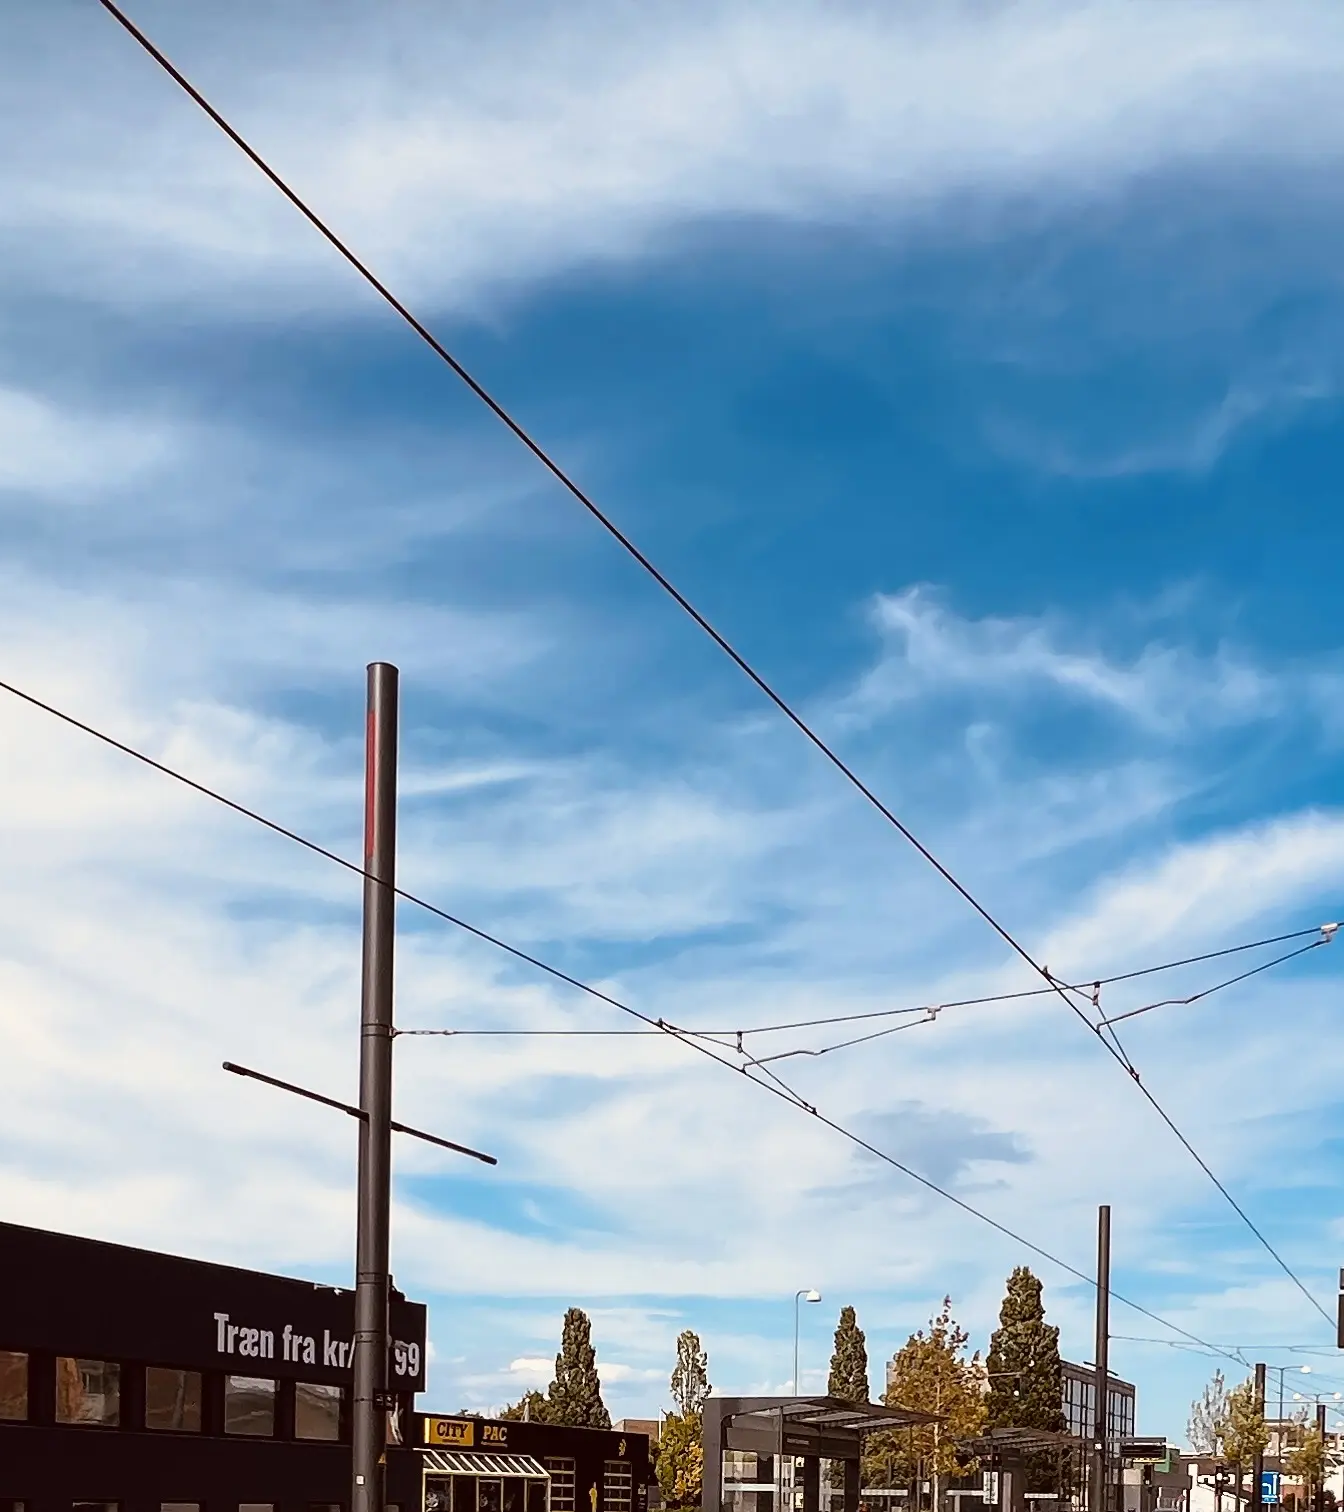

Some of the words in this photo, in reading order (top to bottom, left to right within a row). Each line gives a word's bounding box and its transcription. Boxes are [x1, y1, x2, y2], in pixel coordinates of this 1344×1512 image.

[213, 1312, 274, 1359] Træn
[282, 1324, 316, 1365] fra
[437, 1421, 470, 1438] CITY
[483, 1425, 508, 1442] PAC
